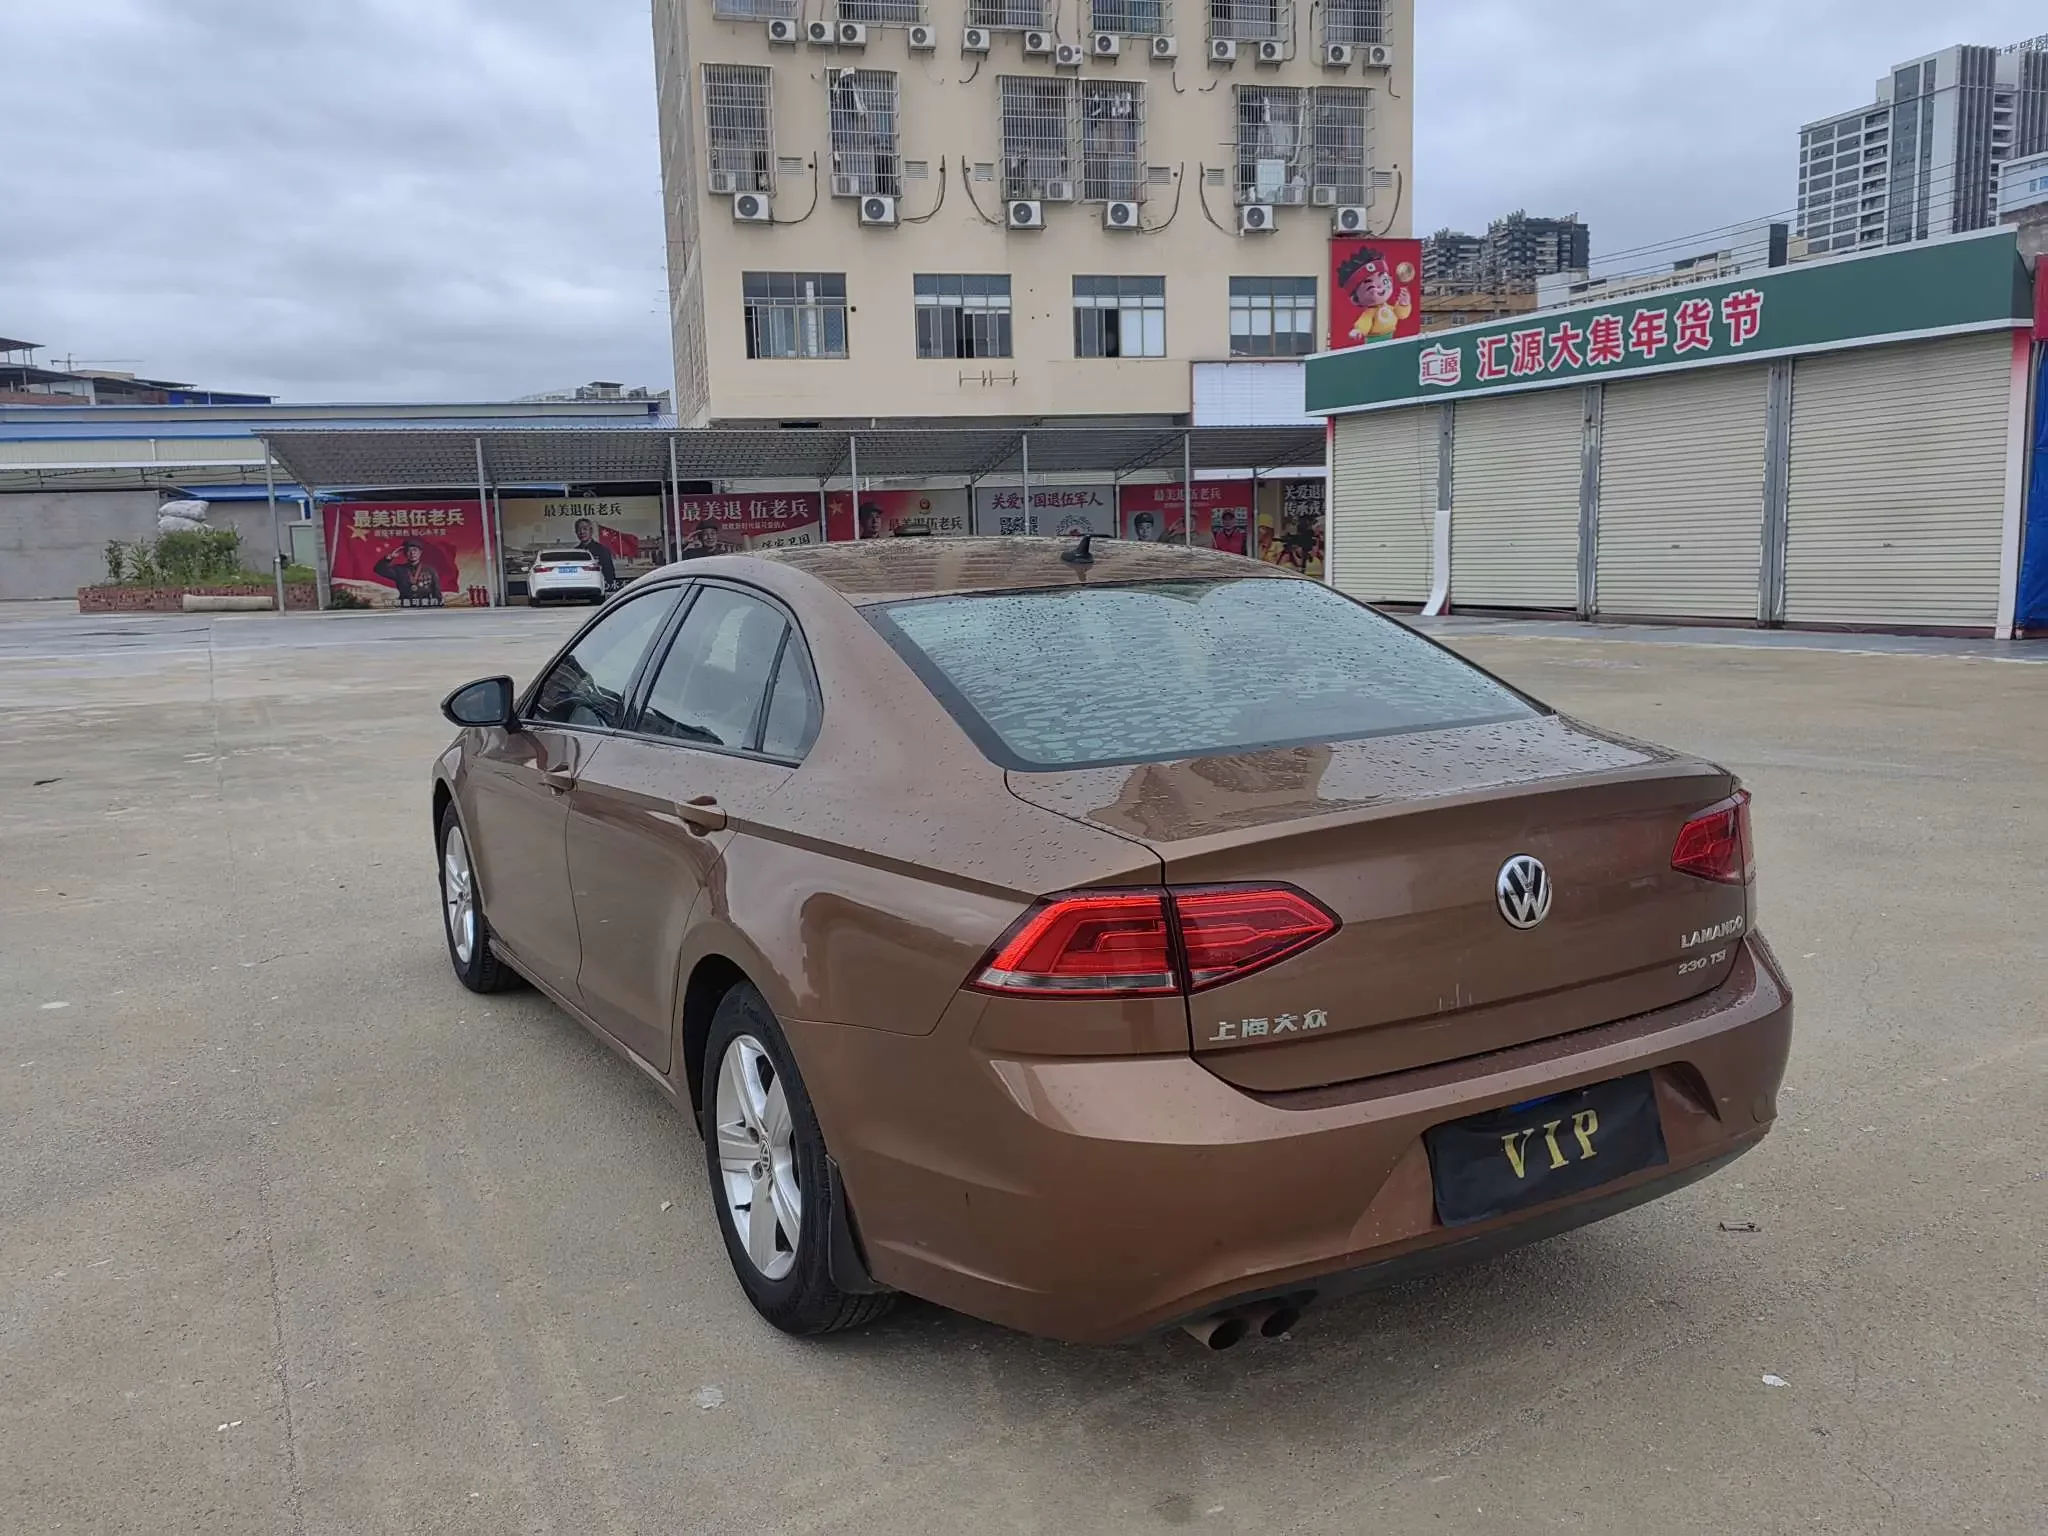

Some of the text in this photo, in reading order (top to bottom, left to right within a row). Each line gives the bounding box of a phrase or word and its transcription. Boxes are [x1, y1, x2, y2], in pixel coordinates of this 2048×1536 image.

[1476, 289, 1764, 381] 汇源大集年货节
[544, 502, 622, 517] 最美退伍老兵
[992, 491, 1104, 510] 关爱中国退伍军人
[353, 508, 465, 528] 最美退伍老兵
[1681, 915, 1743, 948] LAMANDO
[1679, 957, 1707, 975] 230
[1209, 1009, 1328, 1041] 上海大众
[1501, 1109, 1599, 1178] VIP
